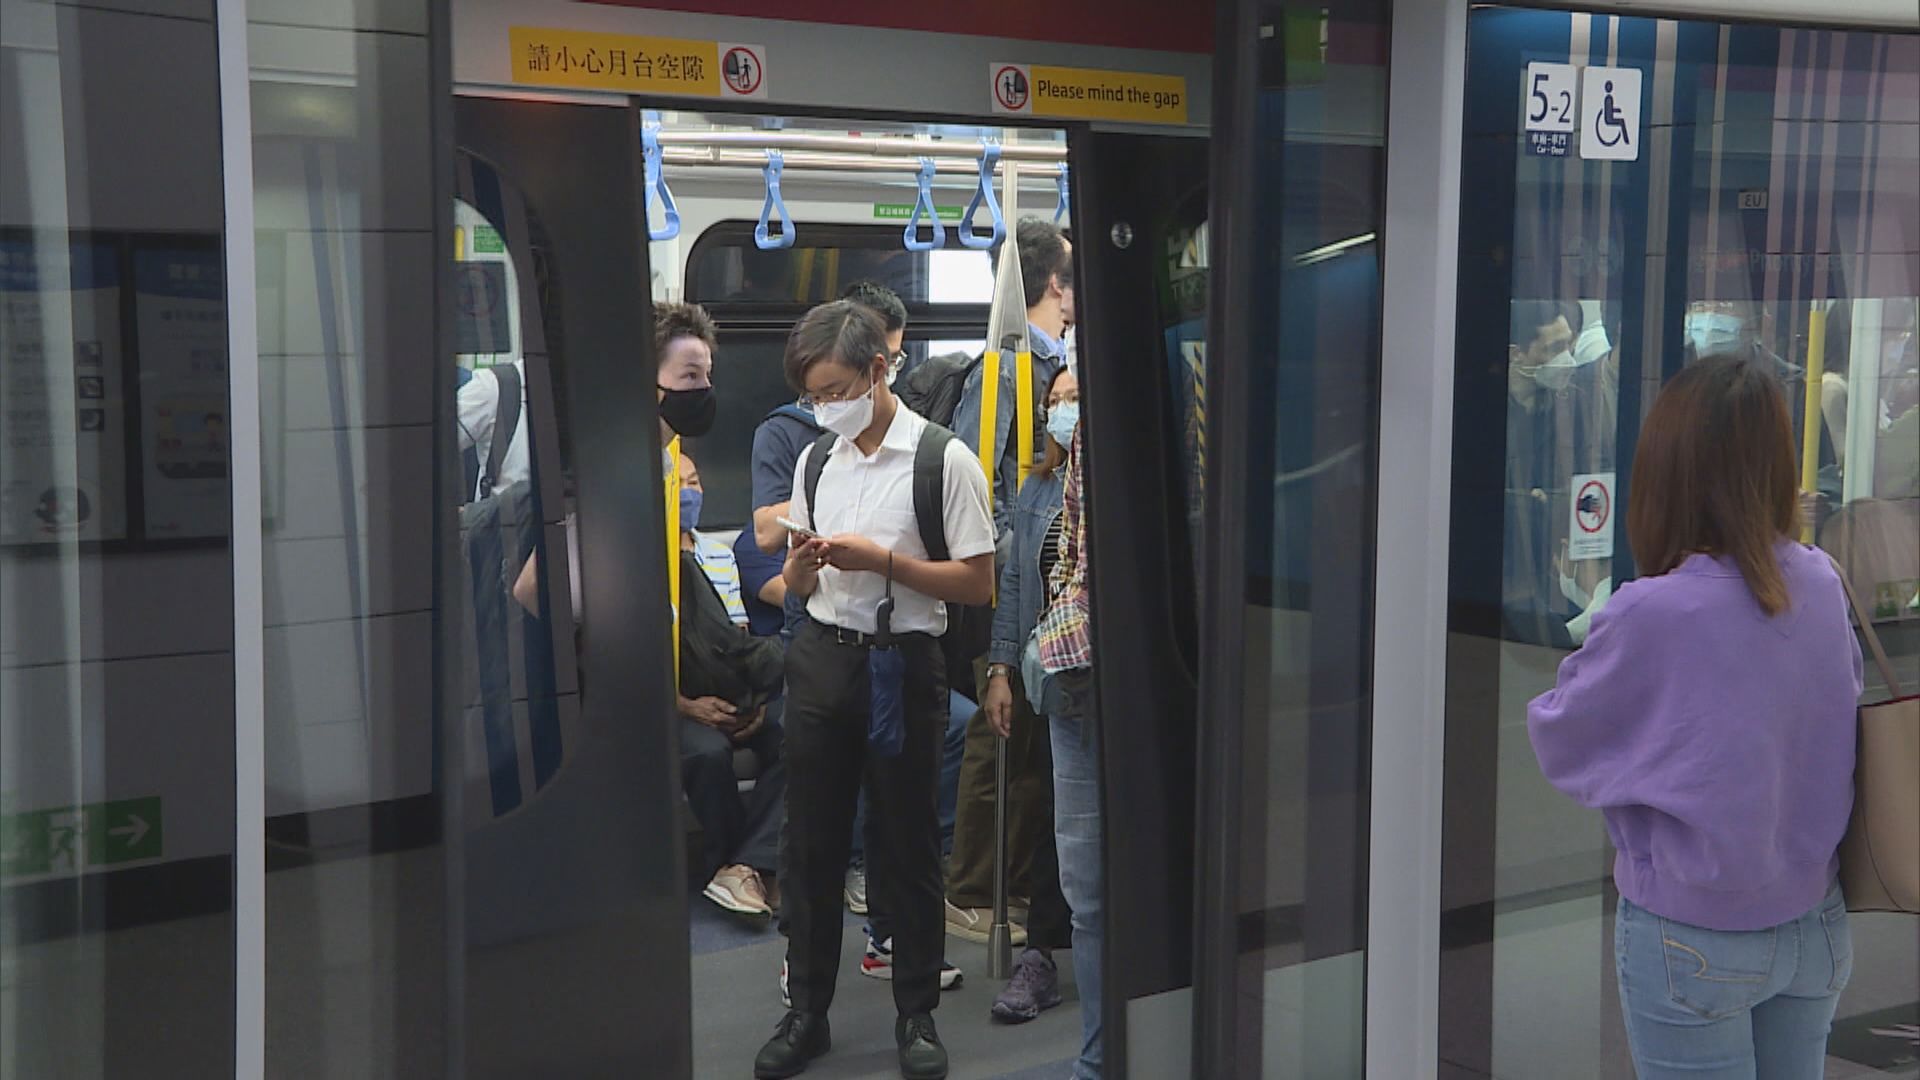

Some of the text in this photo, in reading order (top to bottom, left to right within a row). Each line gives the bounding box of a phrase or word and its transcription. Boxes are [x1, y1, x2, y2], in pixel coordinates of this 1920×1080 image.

[528, 43, 705, 81] 請小心月台空隙
[1037, 79, 1180, 109] Please mind the gap
[1530, 73, 1572, 123] 5-2
